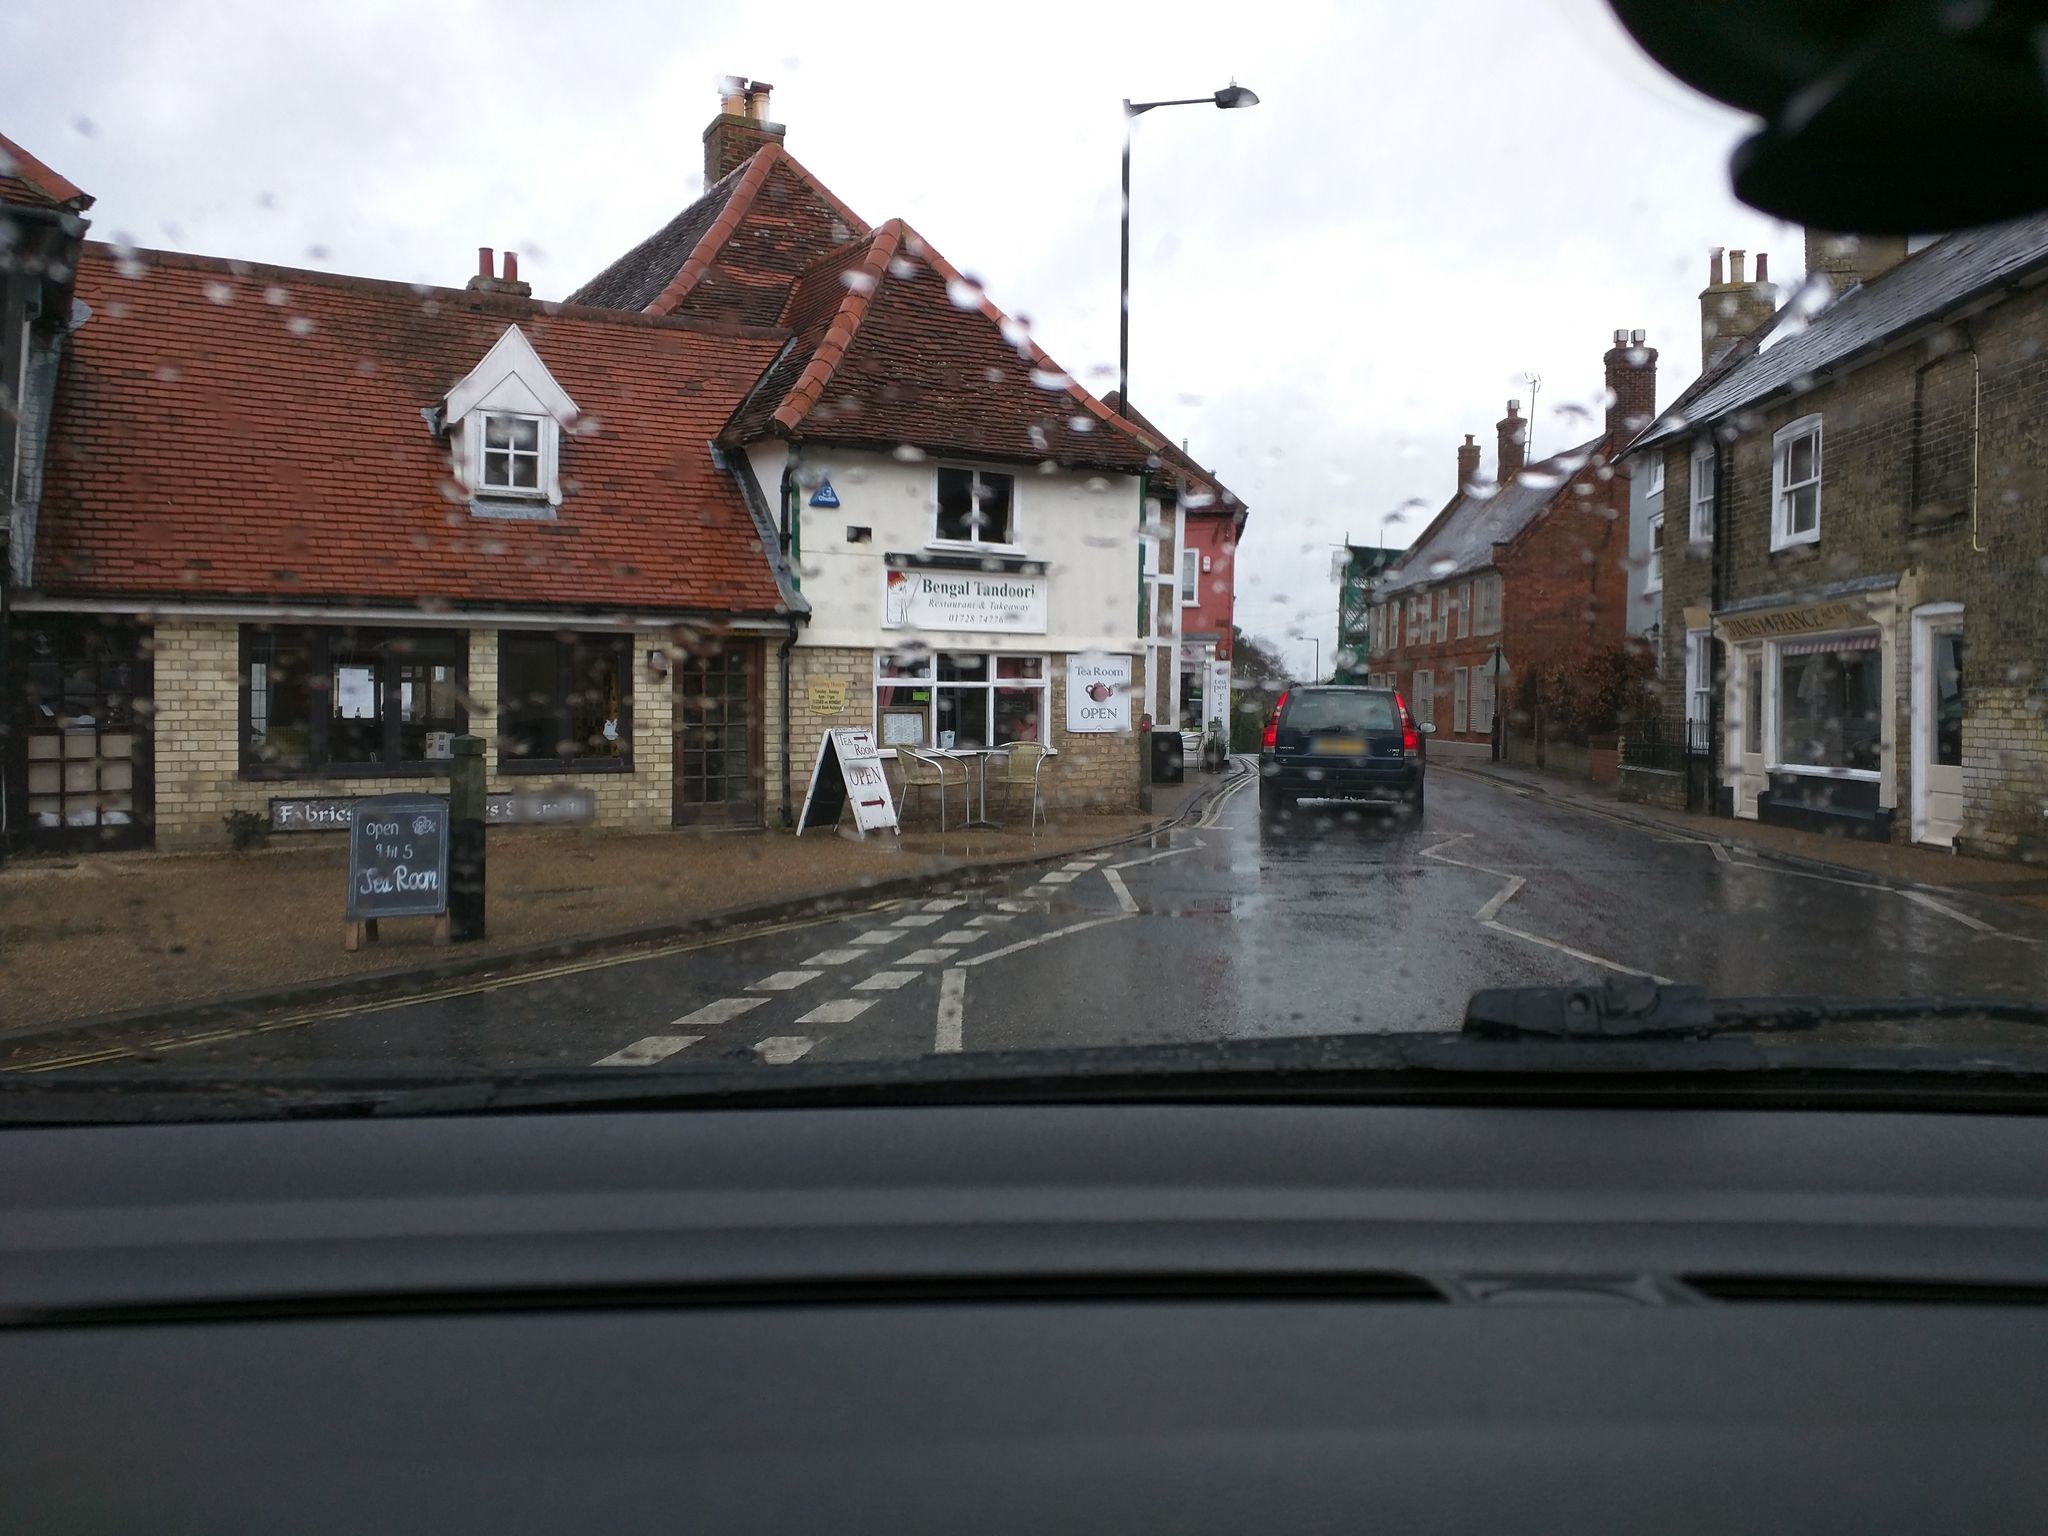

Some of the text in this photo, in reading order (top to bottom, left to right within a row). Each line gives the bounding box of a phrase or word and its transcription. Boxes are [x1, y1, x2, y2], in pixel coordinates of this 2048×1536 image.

[923, 579, 1036, 599] Bengal Tandoori
[928, 599, 1031, 612] Restaurant & Takeaway
[949, 614, 976, 623] 01728
[1075, 666, 1124, 677] Tea Room
[1080, 707, 1118, 720] OPEN
[849, 766, 882, 786] OPEN
[402, 843, 414, 860] 5
[358, 868, 394, 894] Tea
